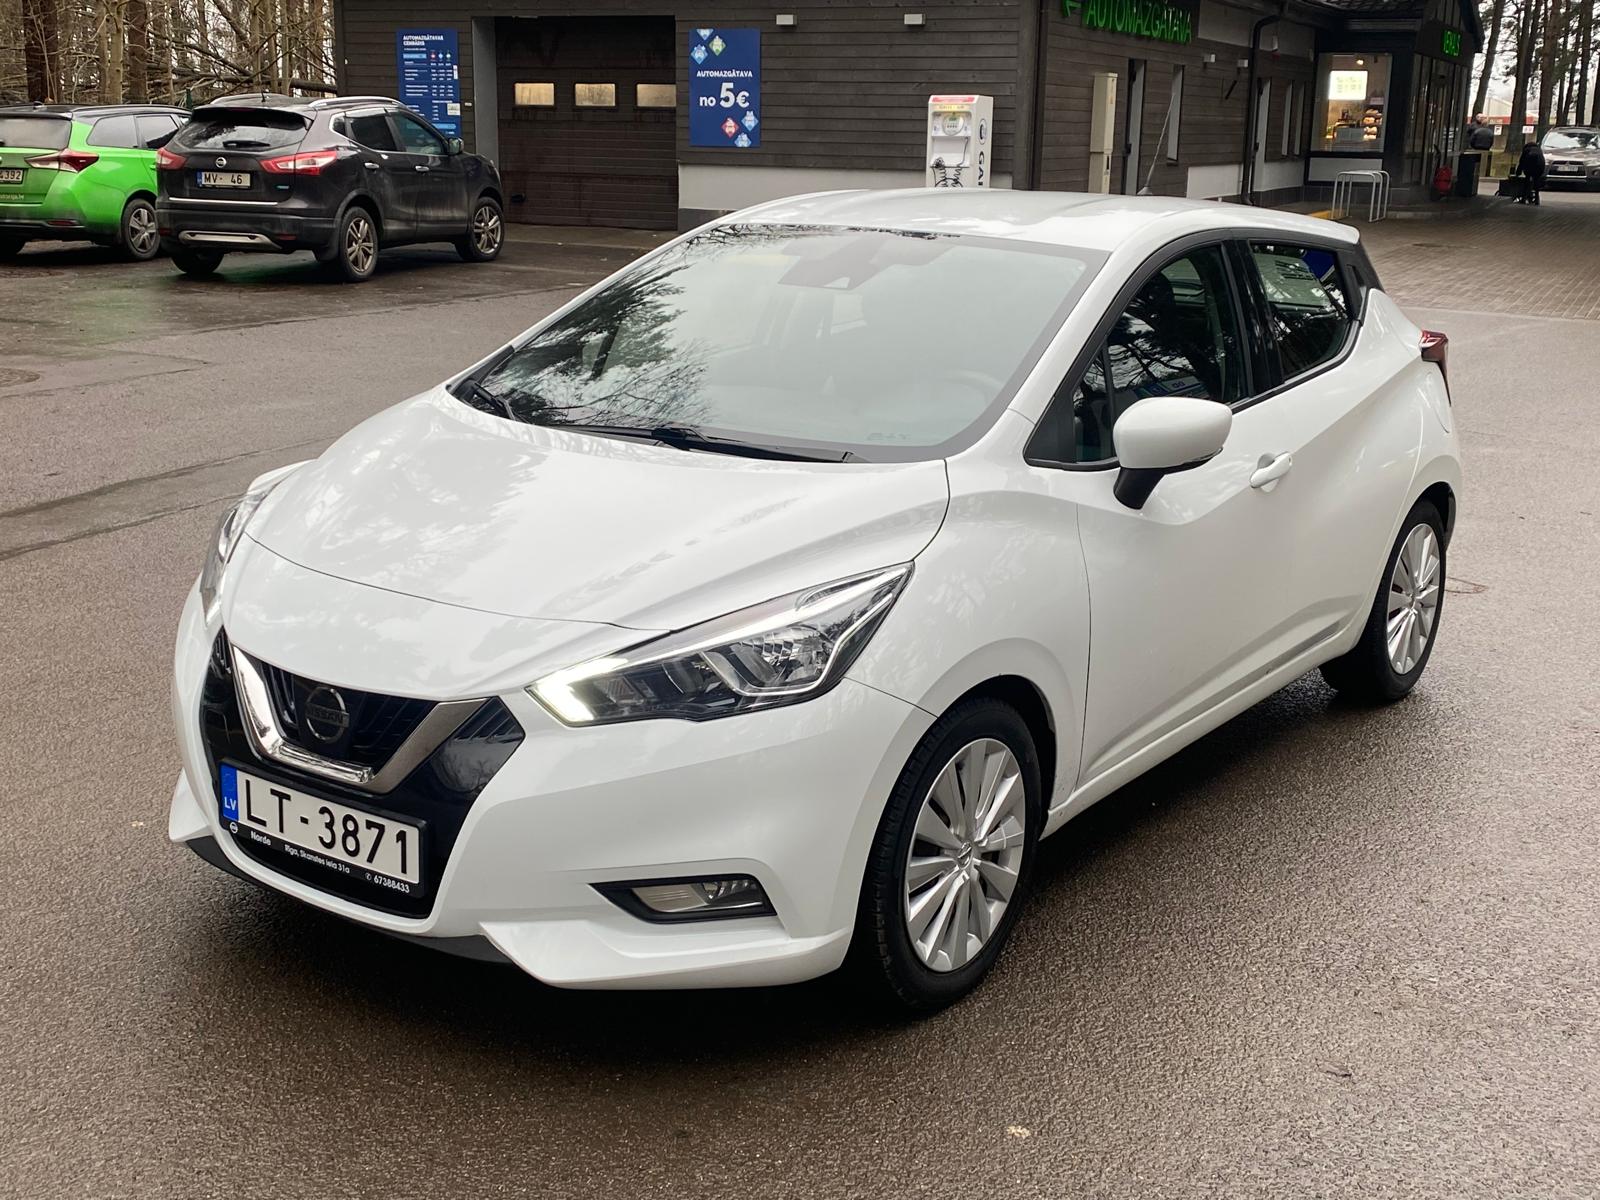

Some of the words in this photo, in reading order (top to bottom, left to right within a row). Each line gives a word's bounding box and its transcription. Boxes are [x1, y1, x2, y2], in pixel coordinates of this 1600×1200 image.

[696, 69, 753, 78] AUTOMAZGĀTAVA
[699, 96, 717, 107] no
[224, 796, 237, 811] LV
[245, 779, 407, 875] LT-3871
[250, 830, 272, 846] Norde
[338, 863, 350, 874] 31a
[373, 874, 410, 894] 67388433
